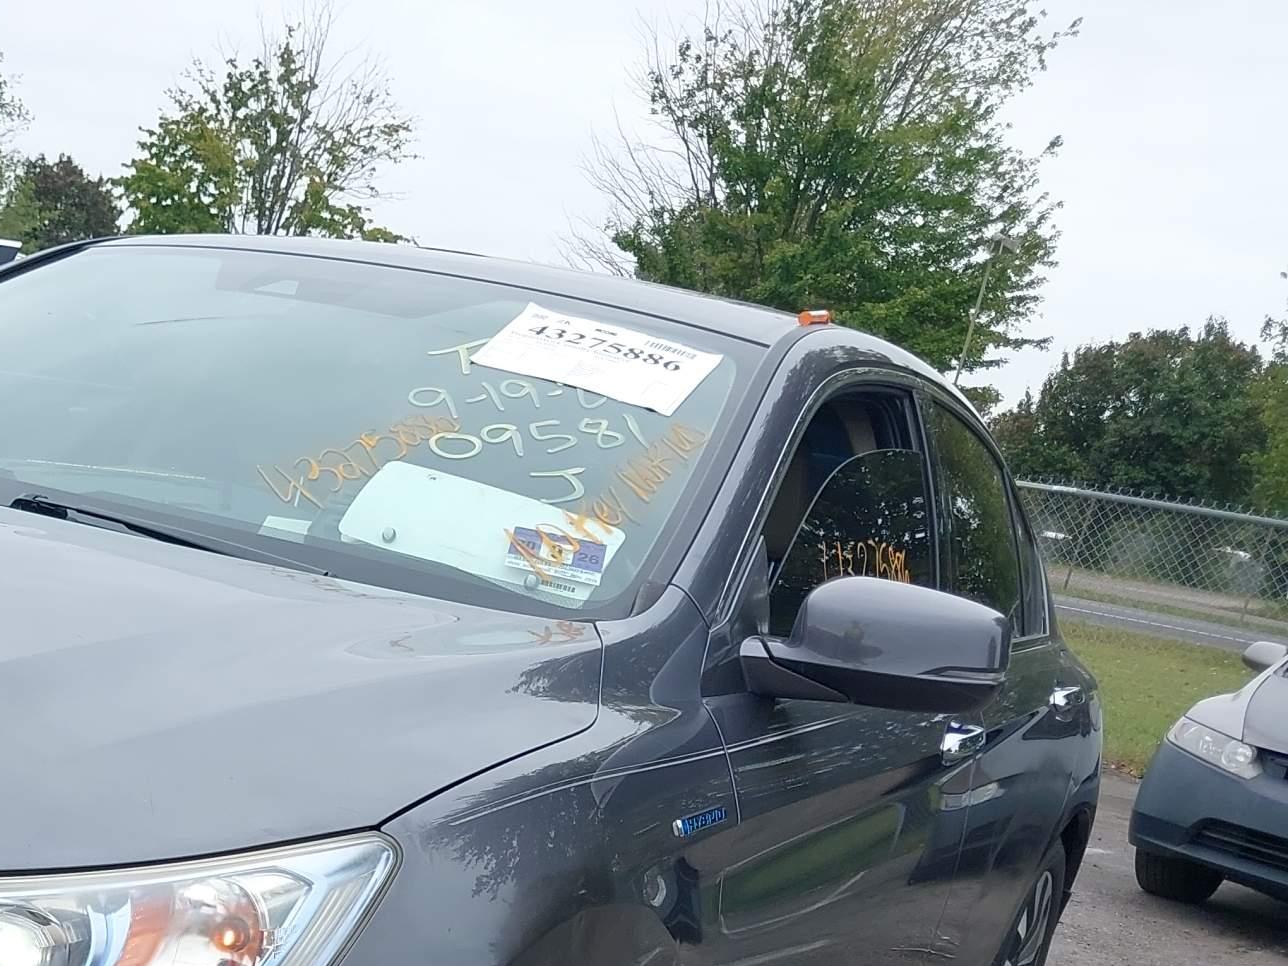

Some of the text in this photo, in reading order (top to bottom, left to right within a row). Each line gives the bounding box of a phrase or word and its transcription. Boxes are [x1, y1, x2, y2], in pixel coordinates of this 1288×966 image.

[528, 325, 682, 372] 43275886
[429, 412, 650, 460] 09581
[578, 552, 600, 565] 26
